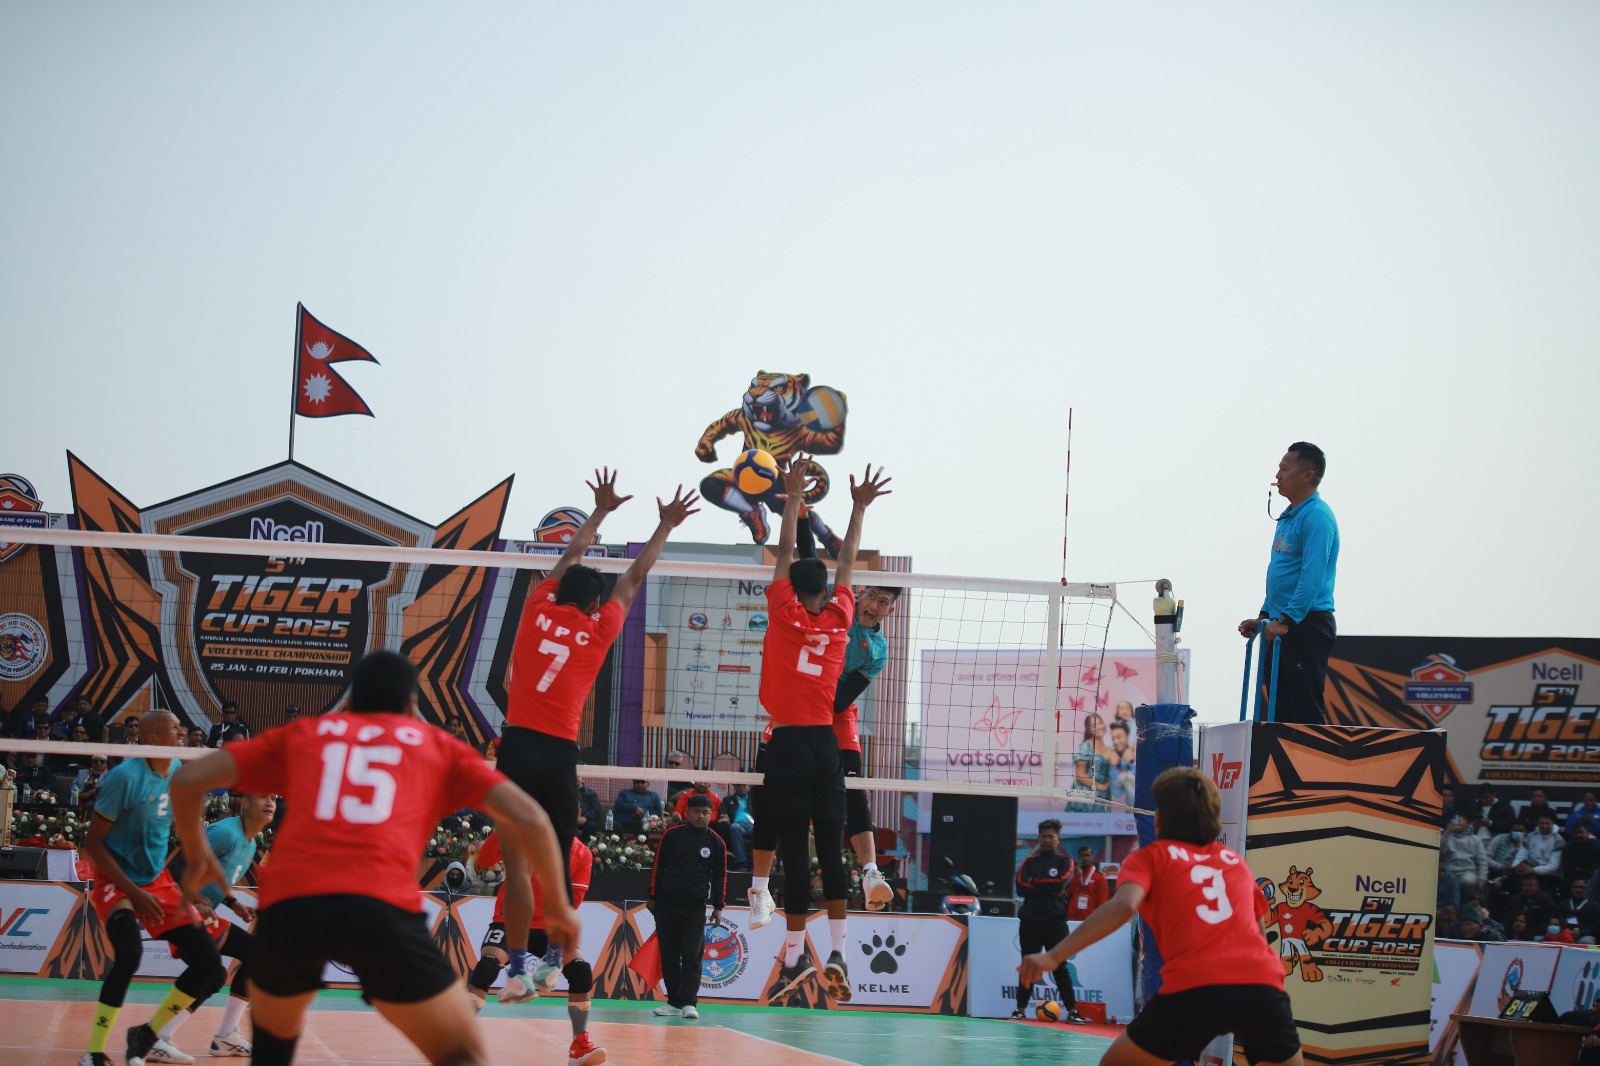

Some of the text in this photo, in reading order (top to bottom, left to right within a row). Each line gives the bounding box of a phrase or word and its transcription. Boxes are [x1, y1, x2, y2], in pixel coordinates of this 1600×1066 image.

[250, 518, 324, 543] Ncell
[207, 574, 364, 615] TIGER
[201, 612, 351, 639] CUP 2025
[535, 613, 590, 646] NPC
[208, 646, 349, 662] VOLLEYBALL CHAMPIONSHIP
[796, 633, 830, 677] 2
[210, 662, 225, 671] 25
[225, 663, 248, 672] JAN
[256, 665, 268, 673] 01
[269, 666, 289, 674] FEB
[294, 667, 345, 678] POKHARA
[536, 638, 571, 693] 7
[1532, 662, 1583, 681] Ncell
[1536, 686, 1575, 704] 5TH
[1486, 706, 1600, 740] TIGE
[948, 750, 1043, 771] vatsalya
[1480, 742, 1600, 762] CUP 202
[314, 741, 404, 825] 15
[157, 793, 169, 816] 2
[1190, 865, 1233, 924] 3
[1355, 874, 1407, 894] Ncell
[1364, 897, 1392, 911] 5TH
[0, 907, 51, 937] VC
[1329, 911, 1431, 939] TIGER
[484, 929, 505, 944] 13
[1322, 938, 1422, 956] CUP 2025
[858, 983, 910, 994] KELME
[1077, 989, 1104, 1002] LIFE
